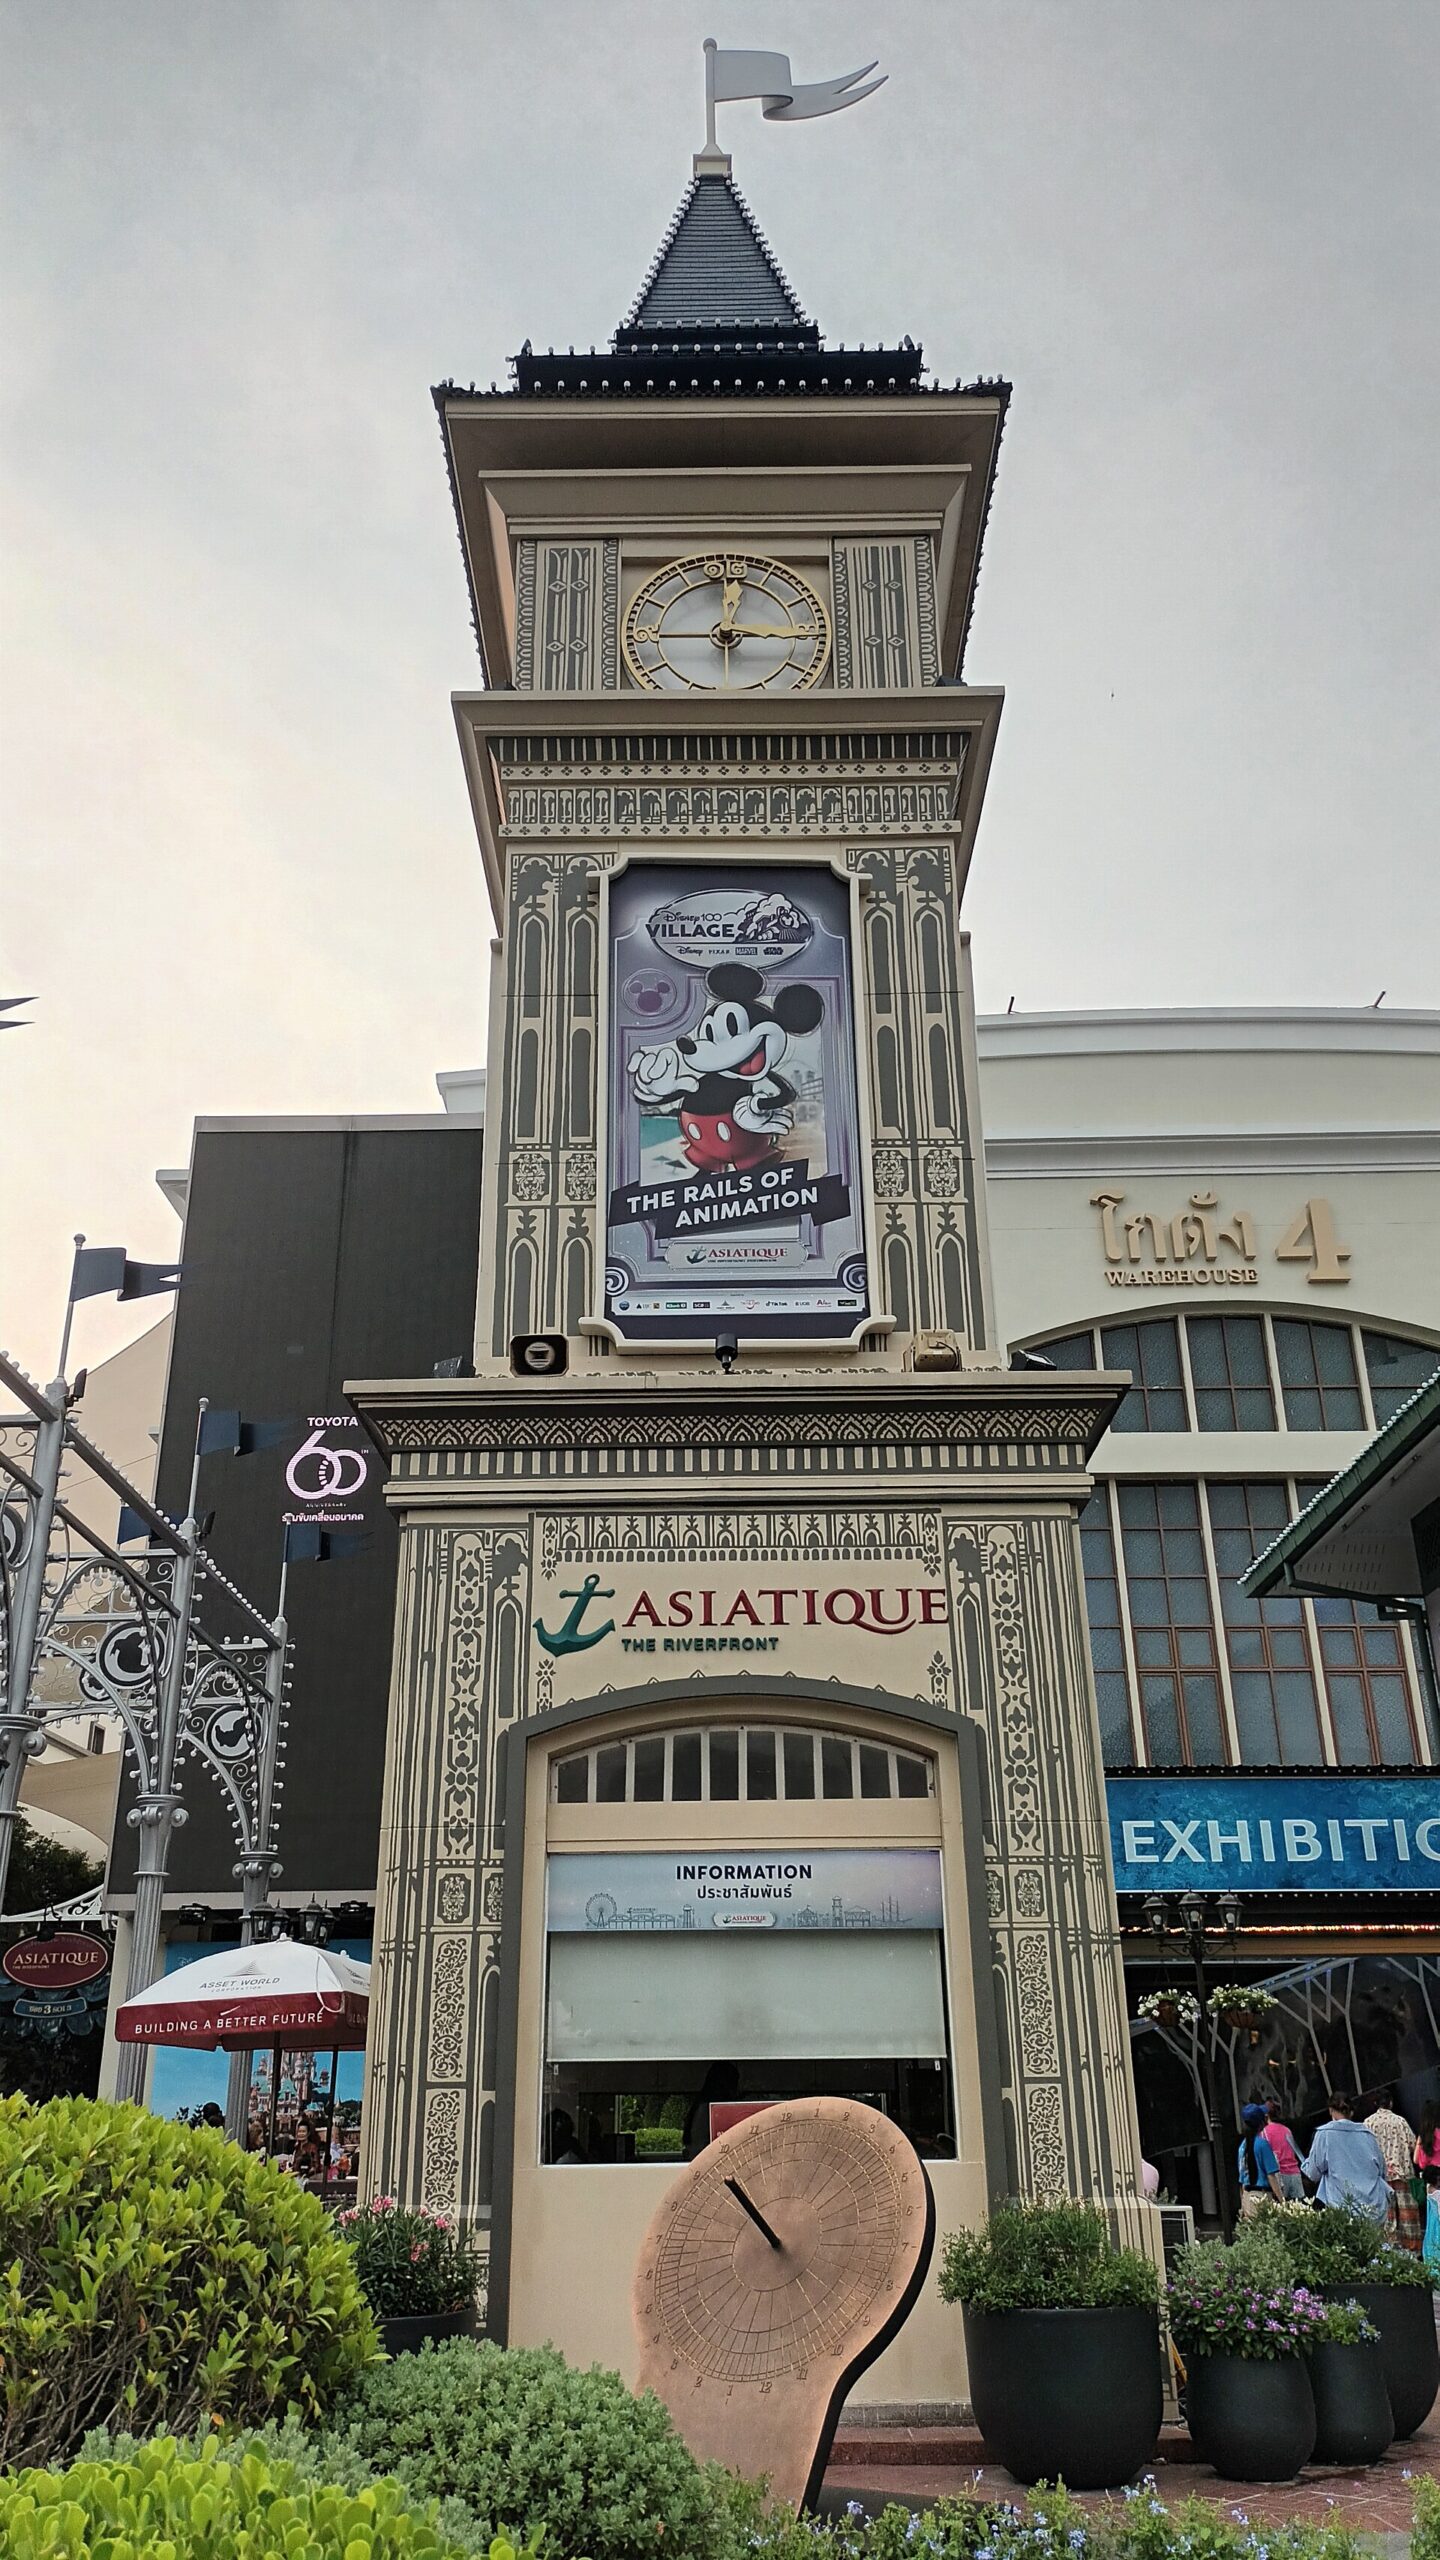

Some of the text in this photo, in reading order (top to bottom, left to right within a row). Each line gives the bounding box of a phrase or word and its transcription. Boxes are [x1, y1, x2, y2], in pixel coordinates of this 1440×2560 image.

[660, 911, 722, 925] Disney 100
[645, 924, 734, 938] VILLAGE
[676, 946, 703, 956] Disney
[627, 1168, 794, 1213] THE RAILS OF
[676, 1187, 818, 1228] ANIMATION
[1090, 1189, 1351, 1284] โกดัง 4
[708, 1248, 787, 1259] ASIATIQUE
[1104, 1268, 1259, 1287] WAREHOUSE
[307, 1417, 358, 1426] TOYOTA
[286, 1430, 367, 1500] 60
[621, 1588, 950, 1635] ASIATIQUE
[621, 1637, 778, 1652] THE RIVERFRONT
[676, 1865, 812, 1880] INFORMATION
[697, 1883, 793, 1899] ประชาสัมพันธ์
[13, 1951, 99, 1966] ASIATIQUE
[199, 1977, 280, 1989] ASSET WORLD
[135, 2012, 323, 2034] BUILDING A BETTER FUTURE
[781, 2112, 793, 2122] 12
[843, 2112, 850, 2121] 2
[749, 2125, 760, 2135] 11
[869, 2124, 876, 2134] 3
[901, 2242, 908, 2253] 7
[831, 2344, 844, 2356] 10
[796, 2368, 808, 2380] 11
[759, 2381, 773, 2394] 12
